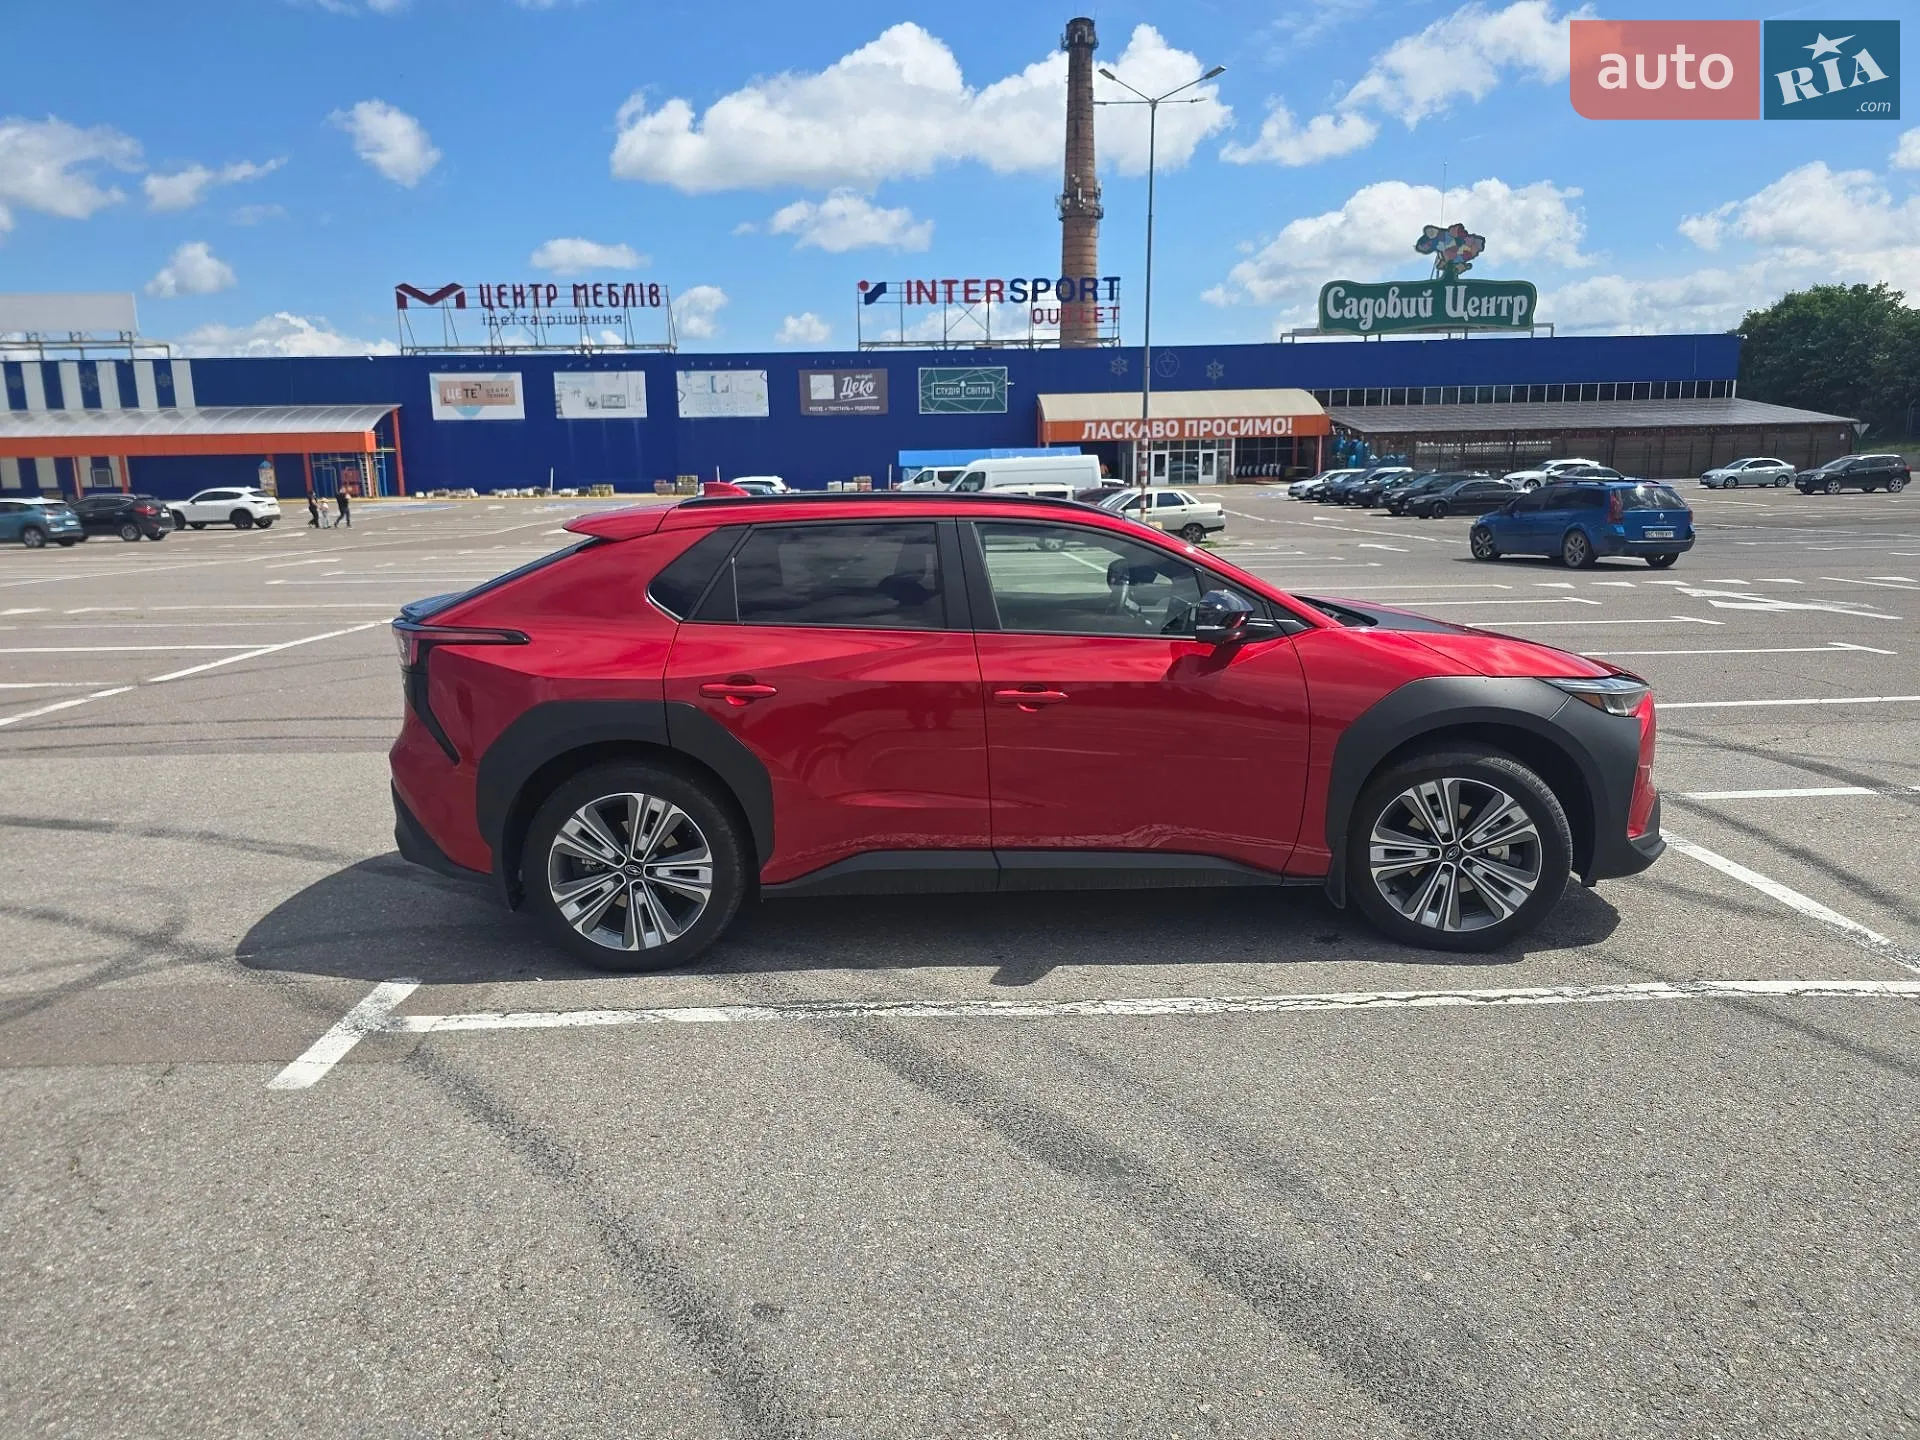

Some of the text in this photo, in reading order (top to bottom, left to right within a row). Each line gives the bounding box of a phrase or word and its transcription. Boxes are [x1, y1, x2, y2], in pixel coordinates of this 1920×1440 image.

[479, 283, 661, 311] ЦЕНТР МЕБЛІВ
[905, 276, 1121, 305] INTERSPORT
[1032, 306, 1120, 325] OUTLET
[1326, 285, 1529, 330] Садовий Центр
[546, 312, 623, 329] рішення
[840, 376, 876, 399] Деко
[1081, 416, 1293, 440] ЛАСКАВО ПРОСИМО!
